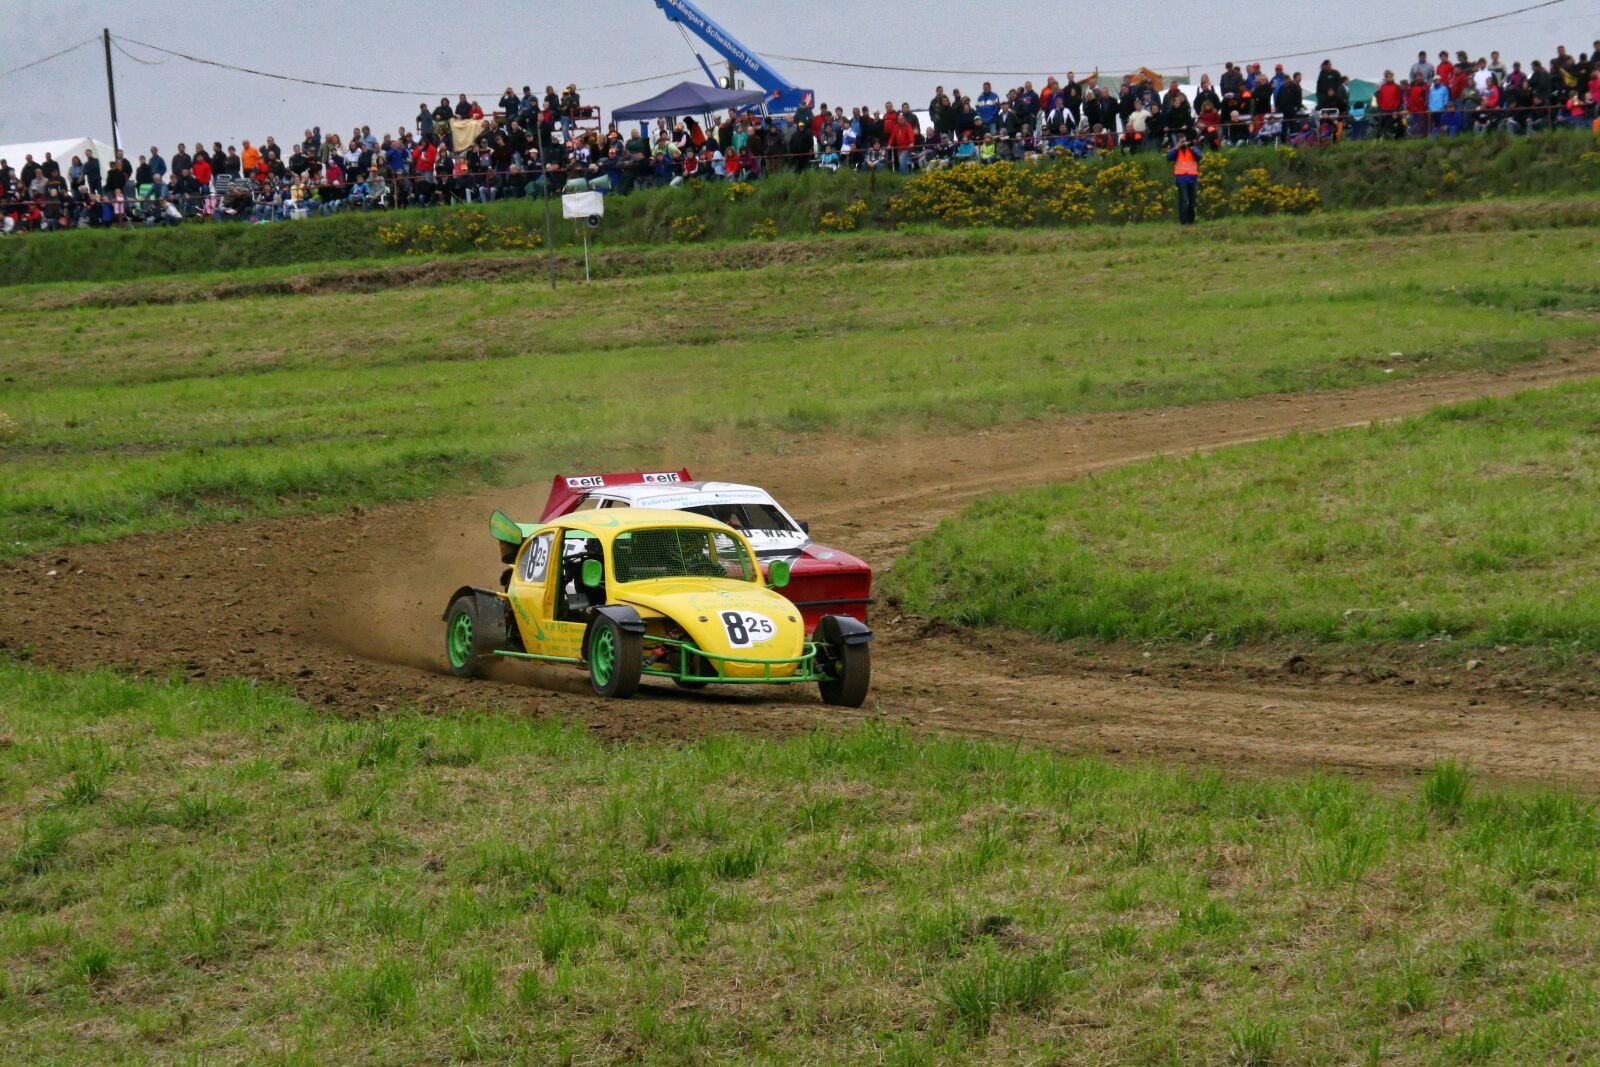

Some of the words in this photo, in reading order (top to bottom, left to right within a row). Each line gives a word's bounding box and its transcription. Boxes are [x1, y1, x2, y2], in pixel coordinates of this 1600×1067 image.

[745, 56, 760, 72] Hall
[580, 476, 602, 486] elf
[656, 473, 678, 483] elf
